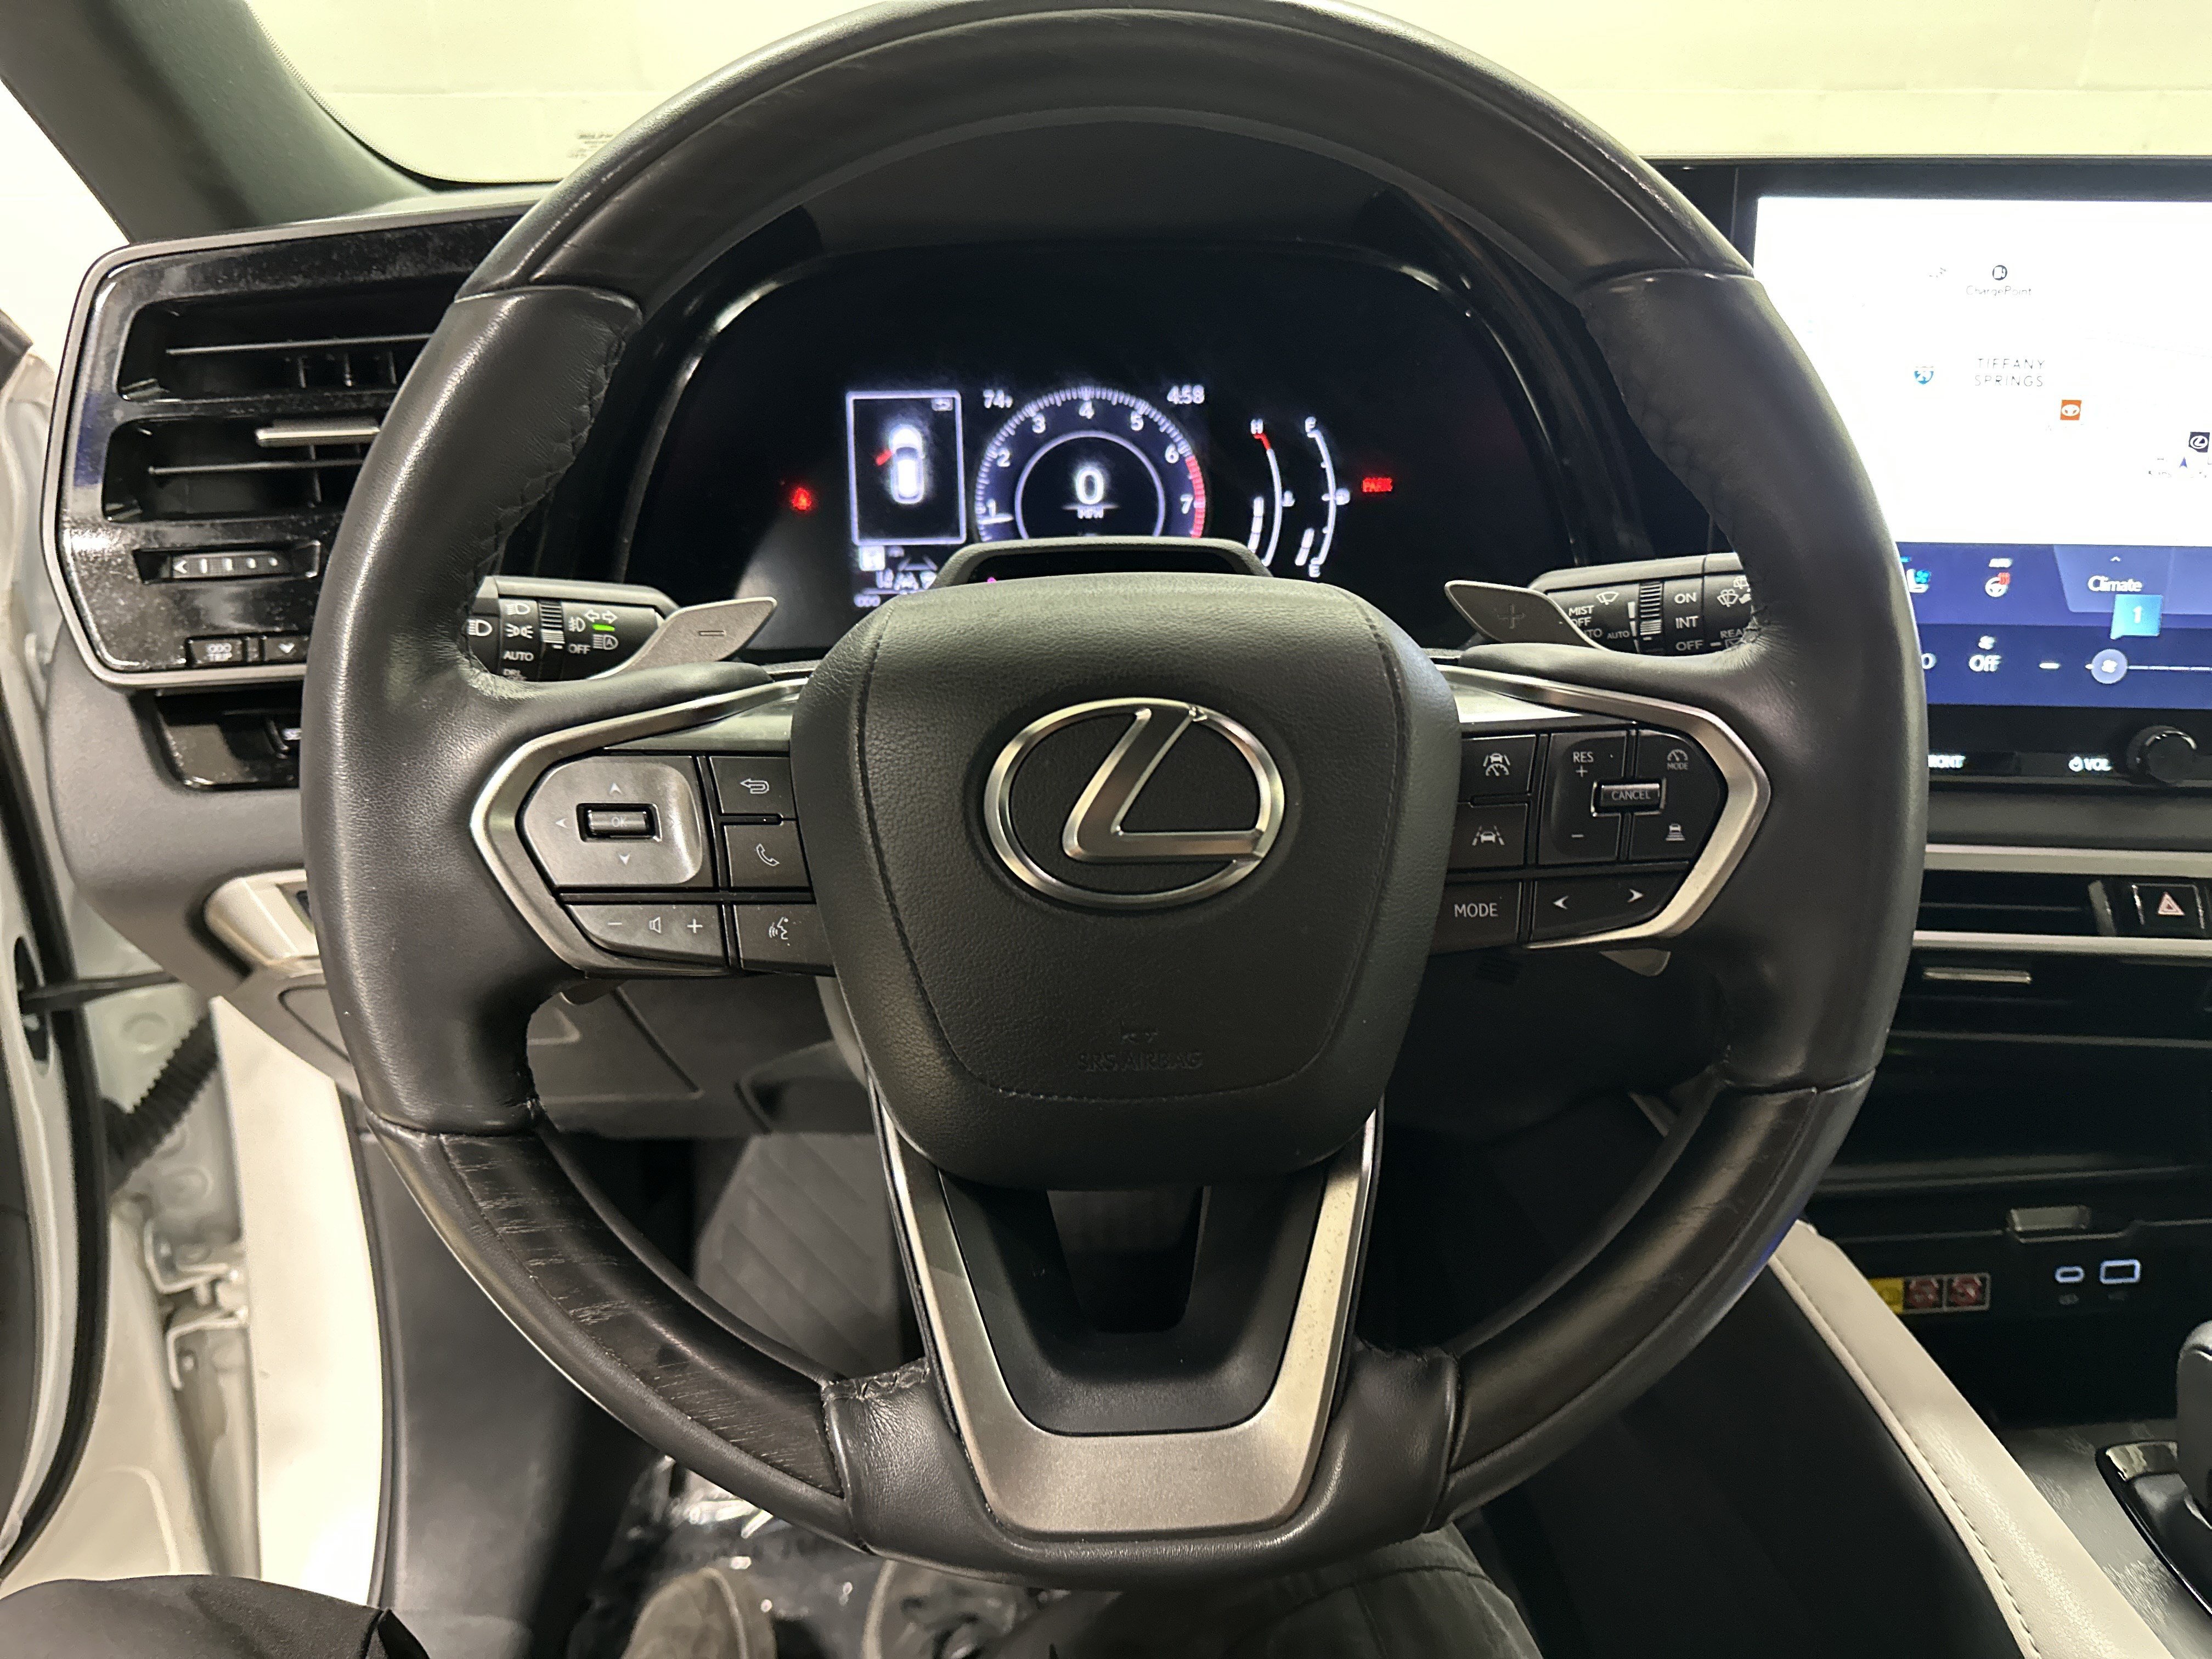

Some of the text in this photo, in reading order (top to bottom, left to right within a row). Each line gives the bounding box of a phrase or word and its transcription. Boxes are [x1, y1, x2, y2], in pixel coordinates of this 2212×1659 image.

[1977, 358, 2045, 370] TIFFANY
[1975, 374, 2044, 387] SPRINGS
[1080, 400, 1094, 419] 4
[1032, 415, 1046, 433] 3
[1131, 412, 1144, 431] 5
[997, 448, 1011, 467] 2
[1165, 443, 1179, 464] 6
[1075, 466, 1104, 505] 0
[1180, 494, 1193, 514] 7
[2087, 575, 2143, 592] Climate
[1674, 592, 1697, 604] ON
[1568, 605, 1594, 617] MIST
[2133, 606, 2142, 624] 1
[1675, 616, 1700, 629] INT
[1607, 630, 1630, 640] AUTO
[568, 644, 591, 654] OFF
[1676, 640, 1704, 651] OFF
[503, 651, 534, 662] AUTO
[1573, 751, 1594, 763] RES
[1667, 762, 1688, 770] MODE
[2084, 758, 2112, 771] VOL
[1611, 789, 1651, 801] CANCEL
[611, 816, 628, 827] OK
[1454, 902, 1499, 918] MODE
